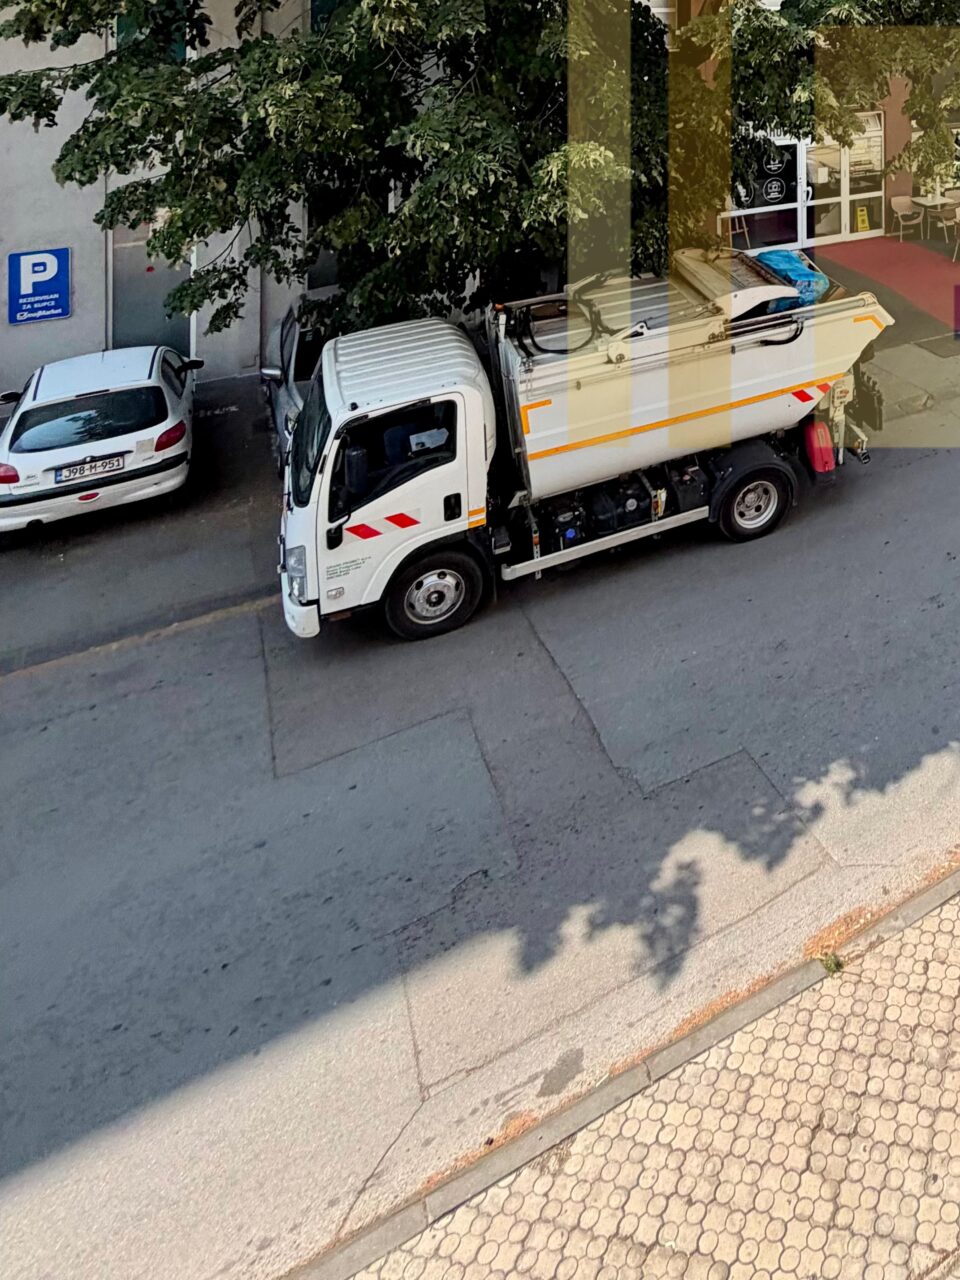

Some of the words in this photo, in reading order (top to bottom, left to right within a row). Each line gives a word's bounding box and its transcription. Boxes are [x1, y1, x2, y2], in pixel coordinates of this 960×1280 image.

[20, 253, 58, 295] P
[19, 293, 60, 304] REZERVISAN
[64, 460, 122, 479] J98-M-951
